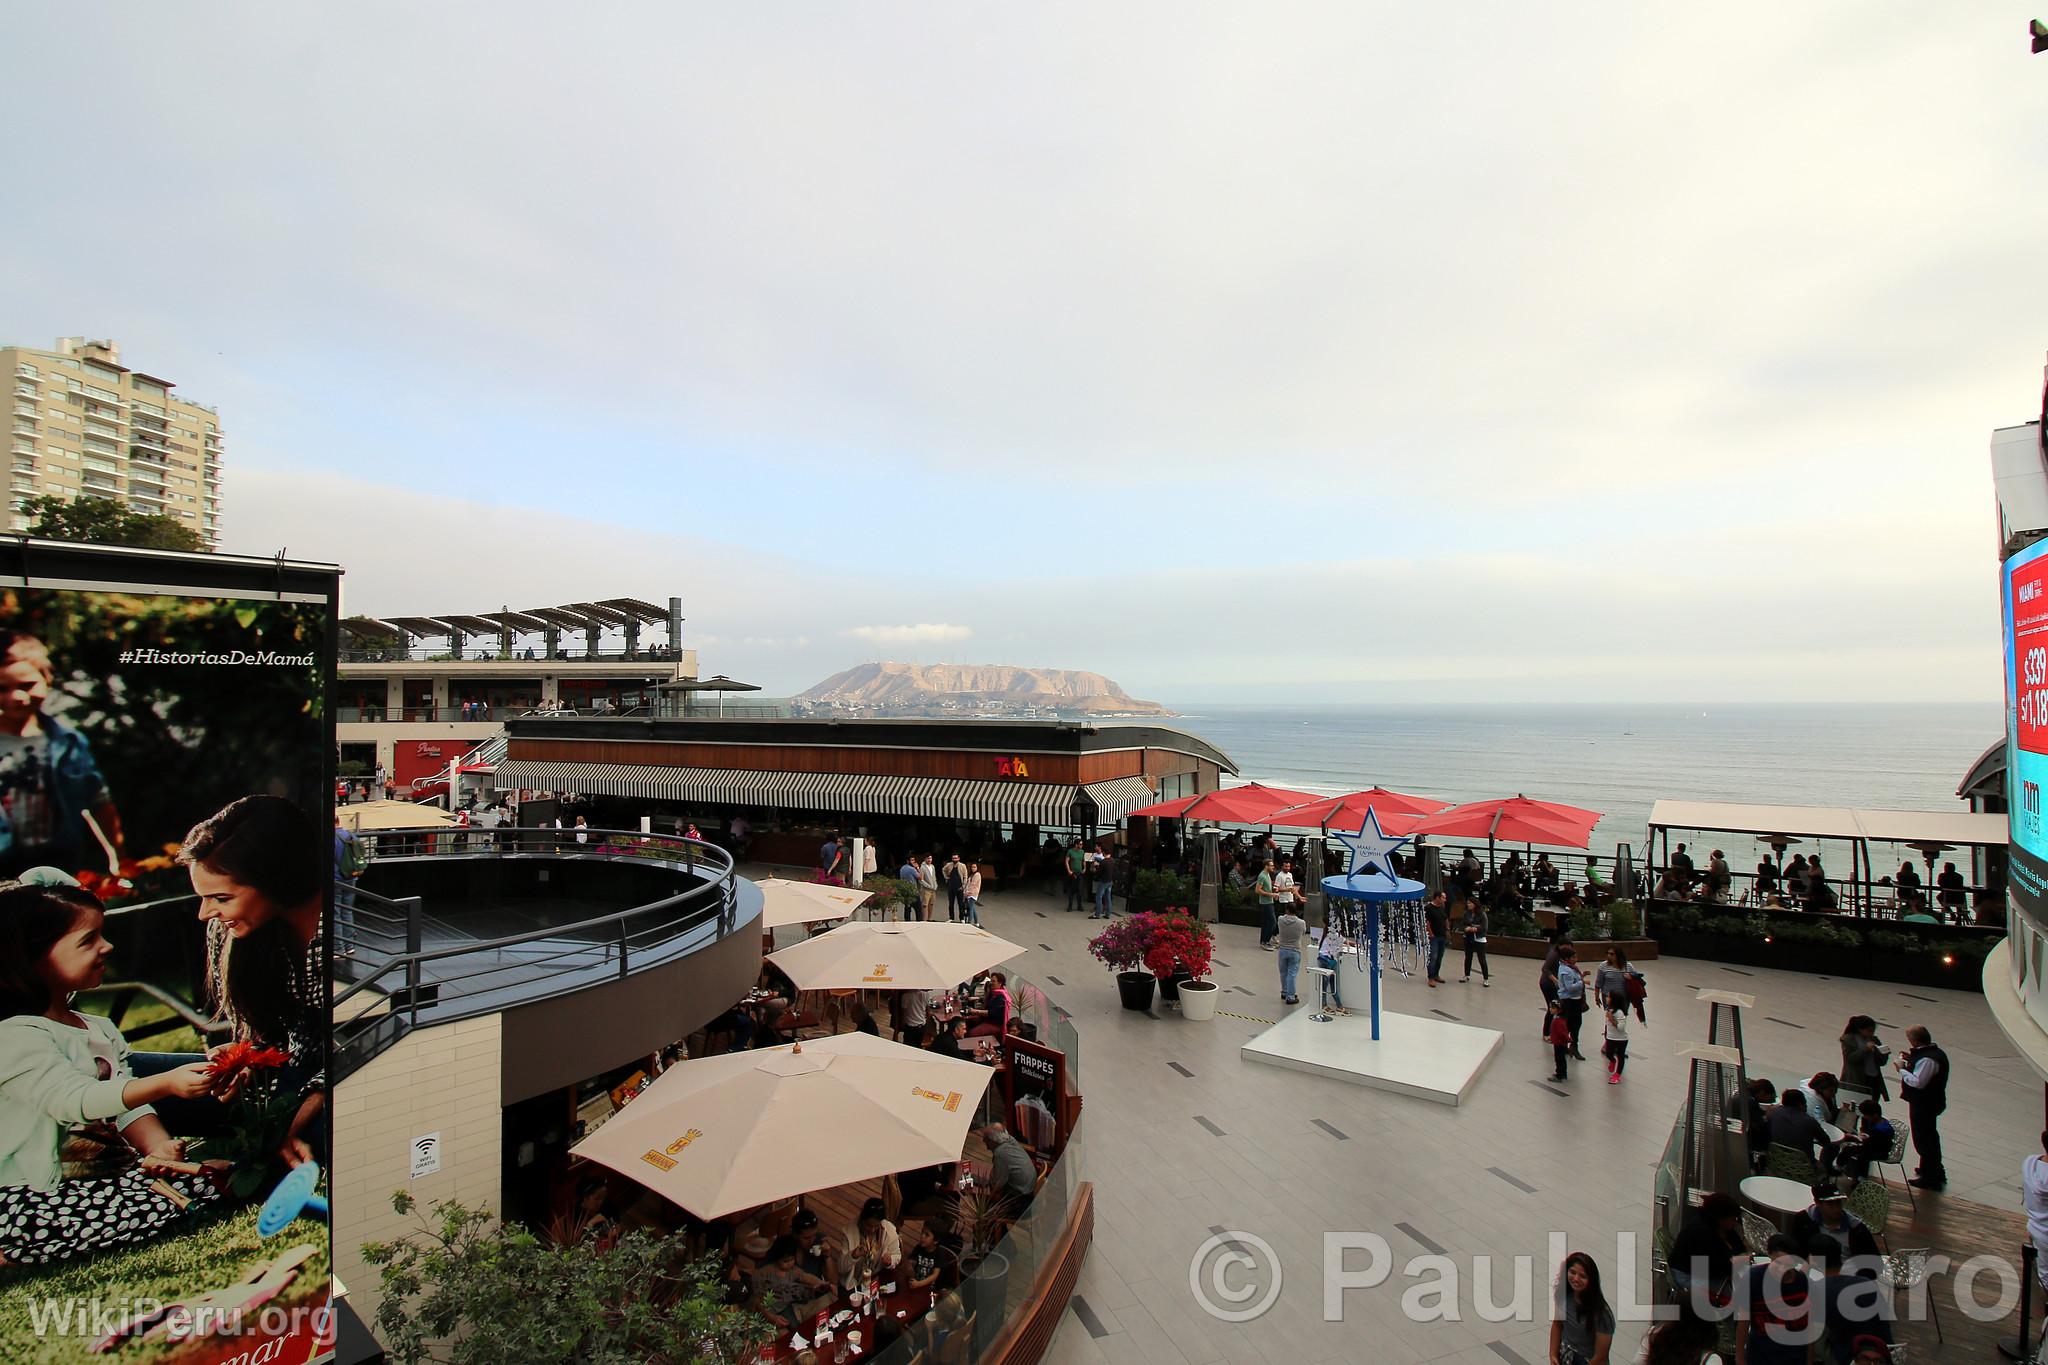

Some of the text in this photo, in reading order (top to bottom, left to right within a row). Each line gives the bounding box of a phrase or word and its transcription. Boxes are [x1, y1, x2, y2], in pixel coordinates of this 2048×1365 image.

[119, 648, 315, 666] #HistoriasDeMamá
[2024, 646, 2047, 688] $339
[1014, 1051, 1054, 1075] FRAPPÉS
